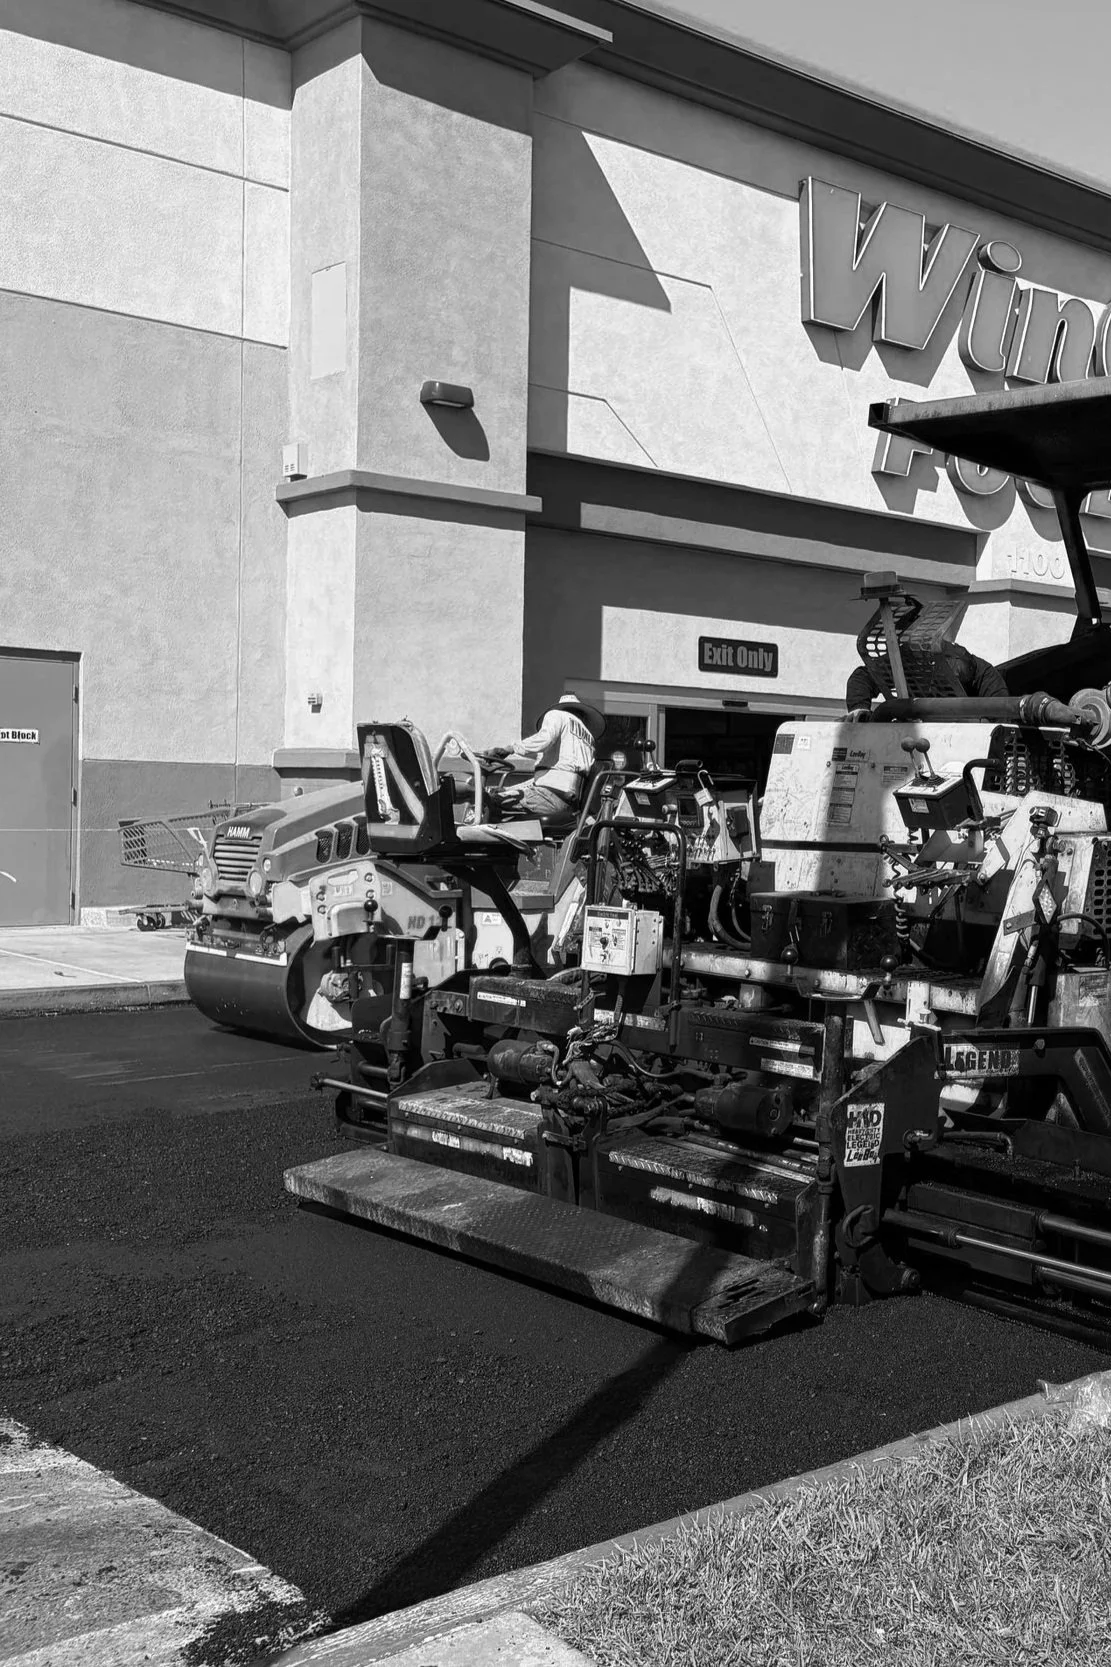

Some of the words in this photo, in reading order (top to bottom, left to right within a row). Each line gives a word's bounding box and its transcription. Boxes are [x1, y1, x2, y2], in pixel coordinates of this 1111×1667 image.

[703, 643, 734, 667] Exit
[736, 646, 774, 672] Only
[11, 730, 37, 740] Block
[227, 826, 251, 839] HAMM
